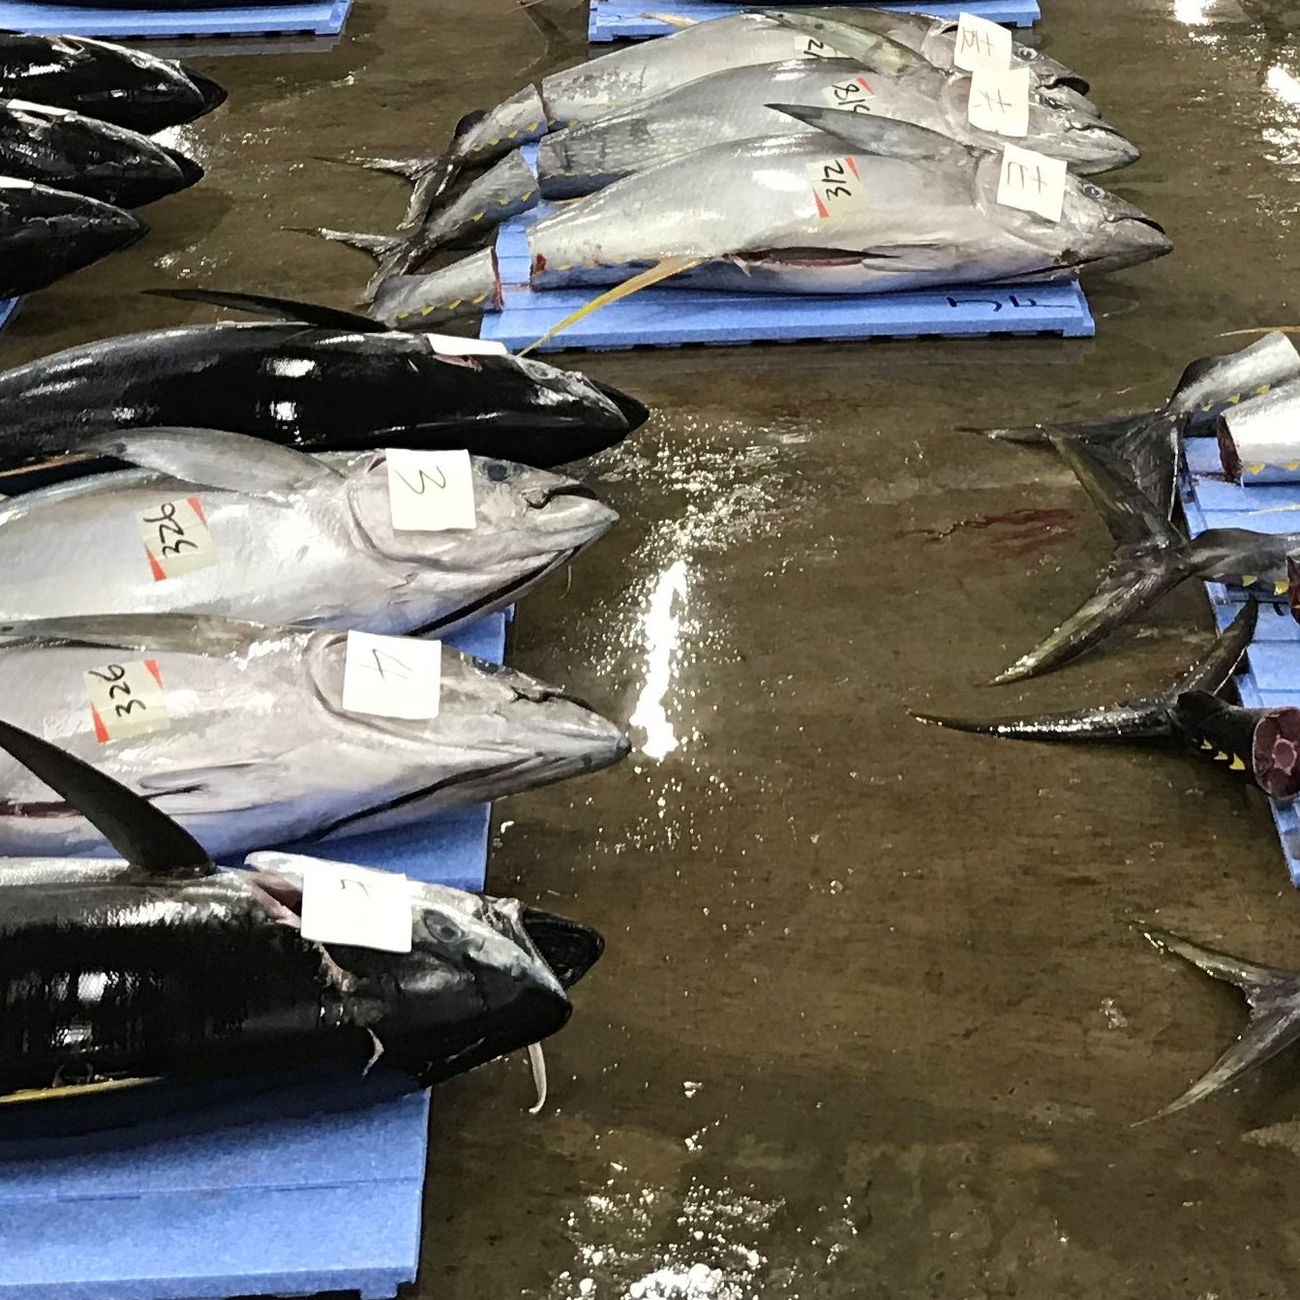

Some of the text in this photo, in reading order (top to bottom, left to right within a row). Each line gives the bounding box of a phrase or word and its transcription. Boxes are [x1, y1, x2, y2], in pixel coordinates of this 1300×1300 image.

[822, 158, 853, 201] 312
[390, 465, 447, 496] 3
[142, 501, 198, 558] 326
[356, 647, 413, 682] 4
[89, 662, 147, 719] 326
